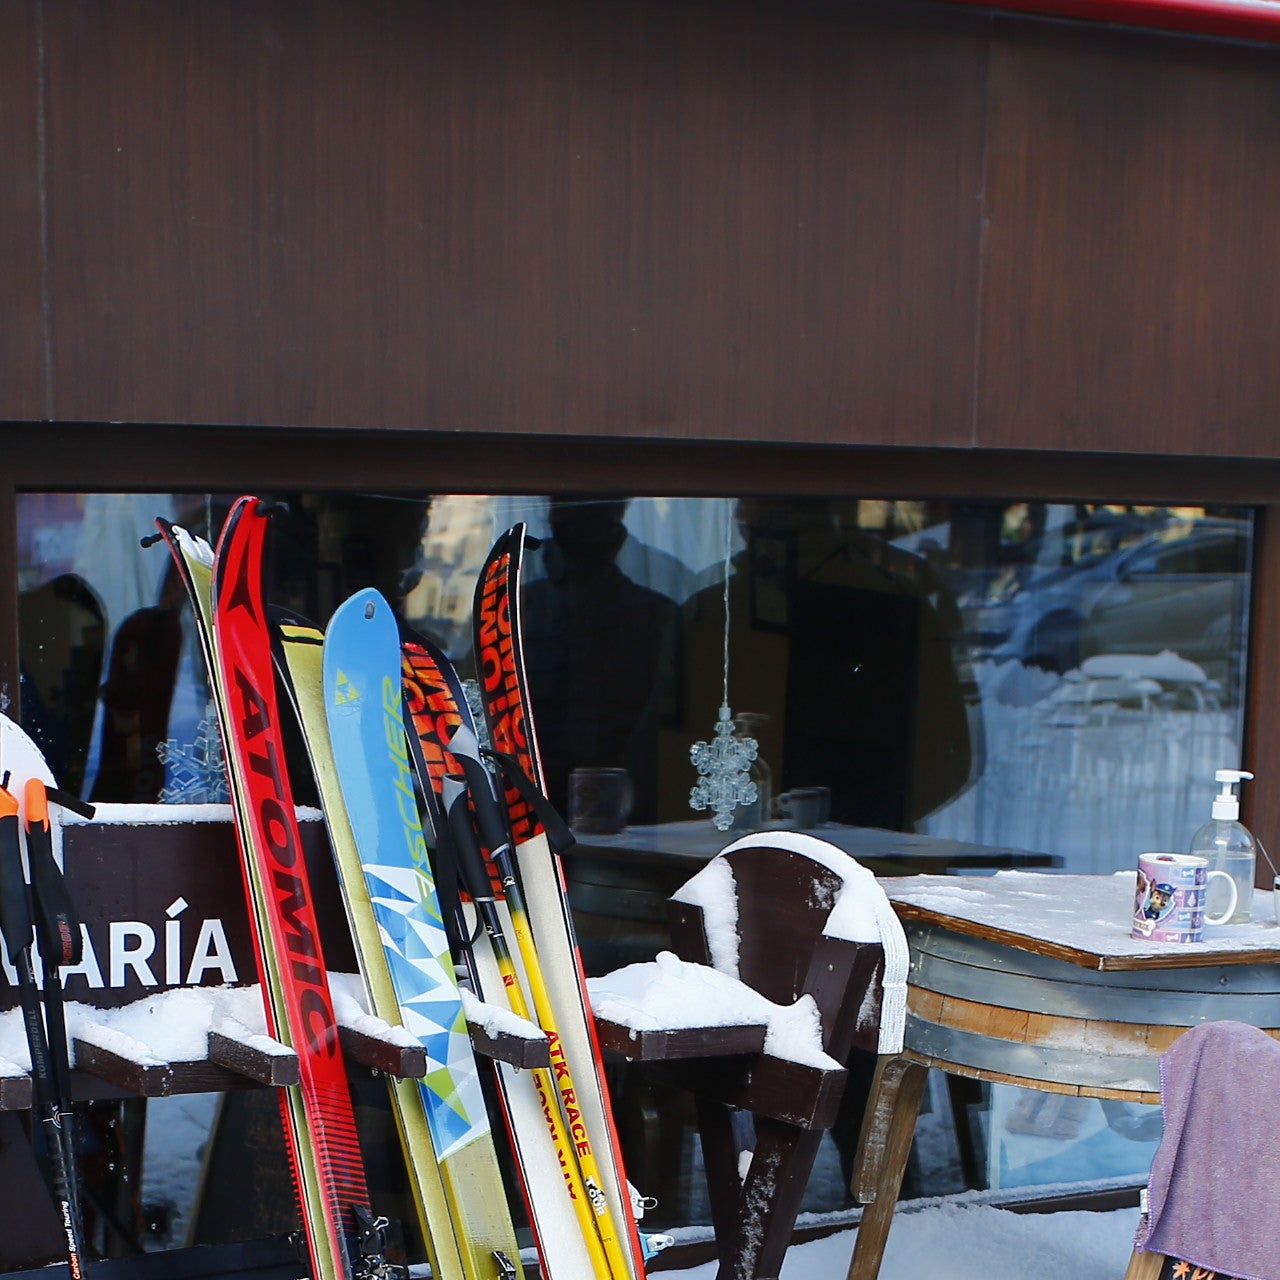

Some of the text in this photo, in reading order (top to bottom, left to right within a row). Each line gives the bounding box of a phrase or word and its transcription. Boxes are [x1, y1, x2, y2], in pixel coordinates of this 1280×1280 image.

[233, 668, 337, 1060] ATOMIC
[382, 675, 444, 926] FISCHER
[561, 1089, 593, 1158] RACE
